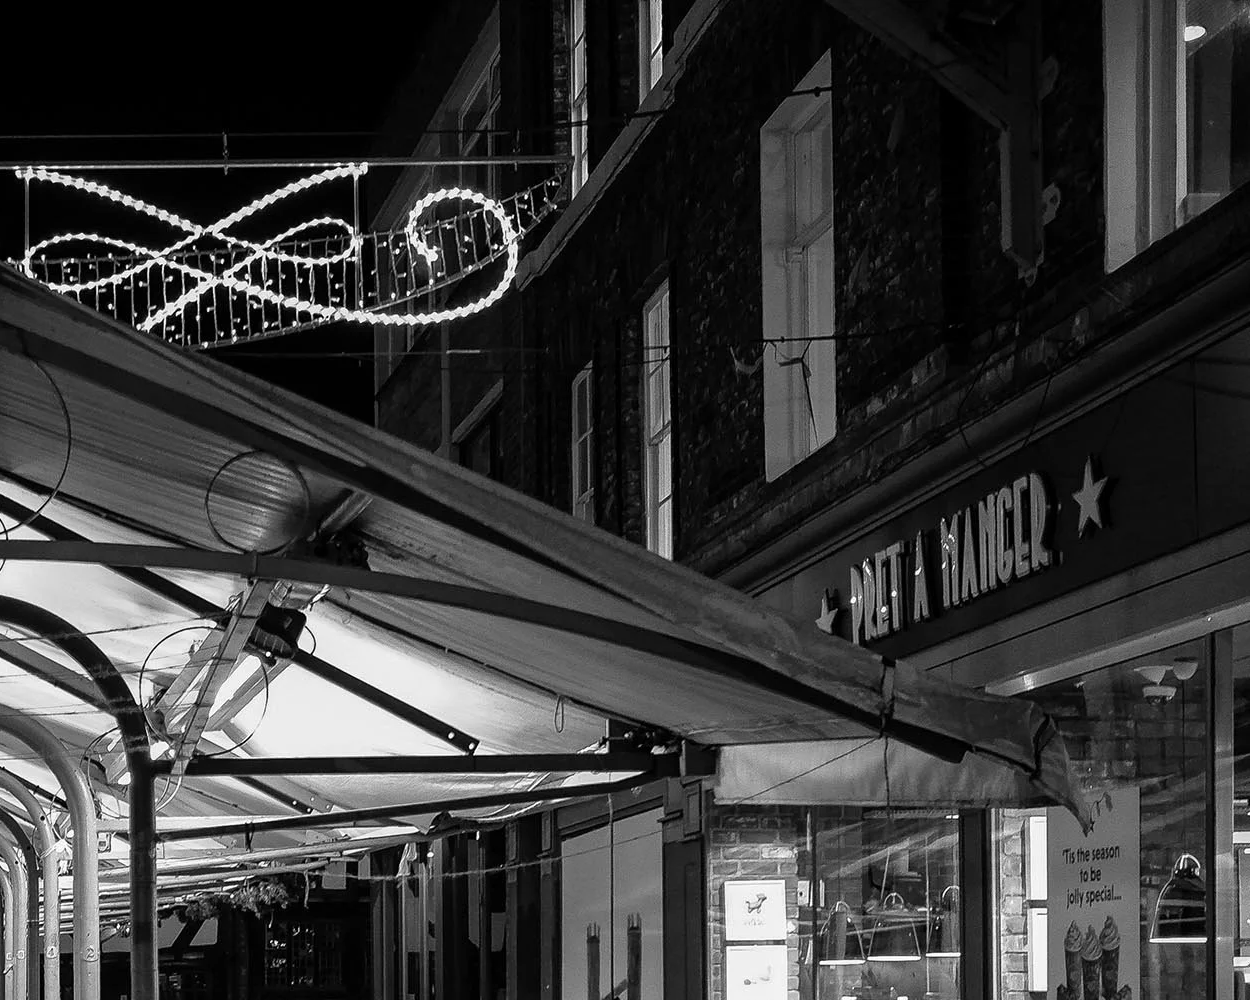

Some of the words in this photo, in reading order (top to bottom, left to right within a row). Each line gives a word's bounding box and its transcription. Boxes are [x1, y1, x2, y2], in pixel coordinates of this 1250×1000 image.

[850, 540, 906, 645] PRET
[913, 529, 931, 623] A
[940, 471, 1054, 608] MANGER
[1062, 848, 1075, 865] 'Tis
[1076, 847, 1091, 864] the
[1091, 844, 1120, 861] season
[1080, 868, 1089, 883] to
[1090, 866, 1102, 882] be
[1067, 887, 1084, 909] jolly
[1085, 884, 1122, 908] special...
[86, 948, 94, 959] 2
